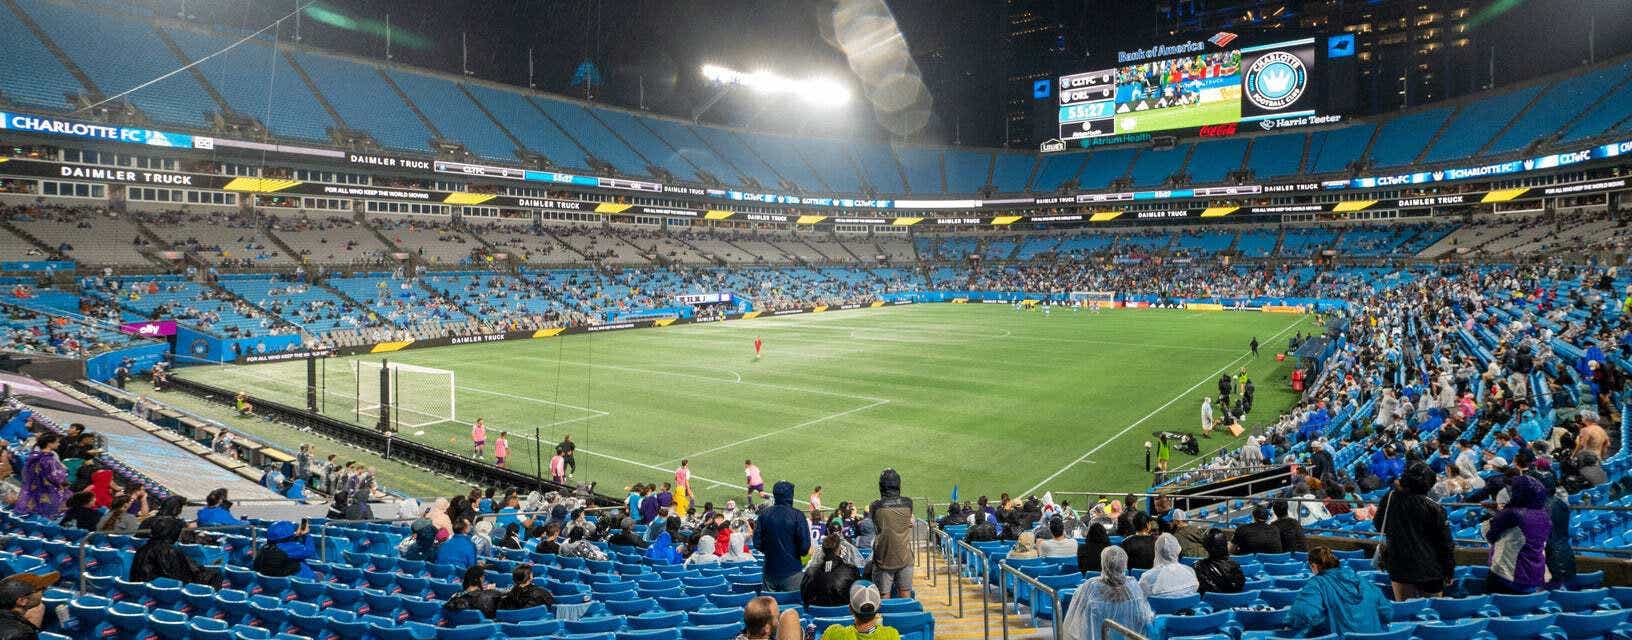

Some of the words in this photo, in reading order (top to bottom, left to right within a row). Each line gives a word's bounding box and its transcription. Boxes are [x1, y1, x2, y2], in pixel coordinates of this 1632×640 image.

[1118, 48, 1145, 62] Bank
[1146, 46, 1158, 58] of
[1158, 41, 1204, 56] America
[1253, 54, 1300, 72] CHARLOTTE
[1103, 74, 1110, 82] 0
[1072, 92, 1089, 100] ORL
[1252, 94, 1286, 106] FOOTBALL
[1286, 88, 1300, 102] CLUB
[1068, 102, 1104, 120] 55:27
[1276, 118, 1307, 128] Harris
[1308, 115, 1341, 124] Teeter
[12, 117, 118, 138] CHARLOTTE
[121, 128, 142, 142] FC
[1093, 135, 1122, 144] Atrium
[1124, 133, 1152, 142] Health
[351, 154, 396, 166] DAIMLER
[401, 159, 429, 169] TRUCK
[61, 167, 136, 181] DAIMLER
[144, 173, 192, 185] TRUCK
[519, 199, 554, 208] DAIMLER
[1398, 199, 1434, 207] DAIMLER
[1438, 196, 1463, 204] TRUCK
[139, 324, 160, 335] ally
[452, 336, 482, 344] DAIMLER
